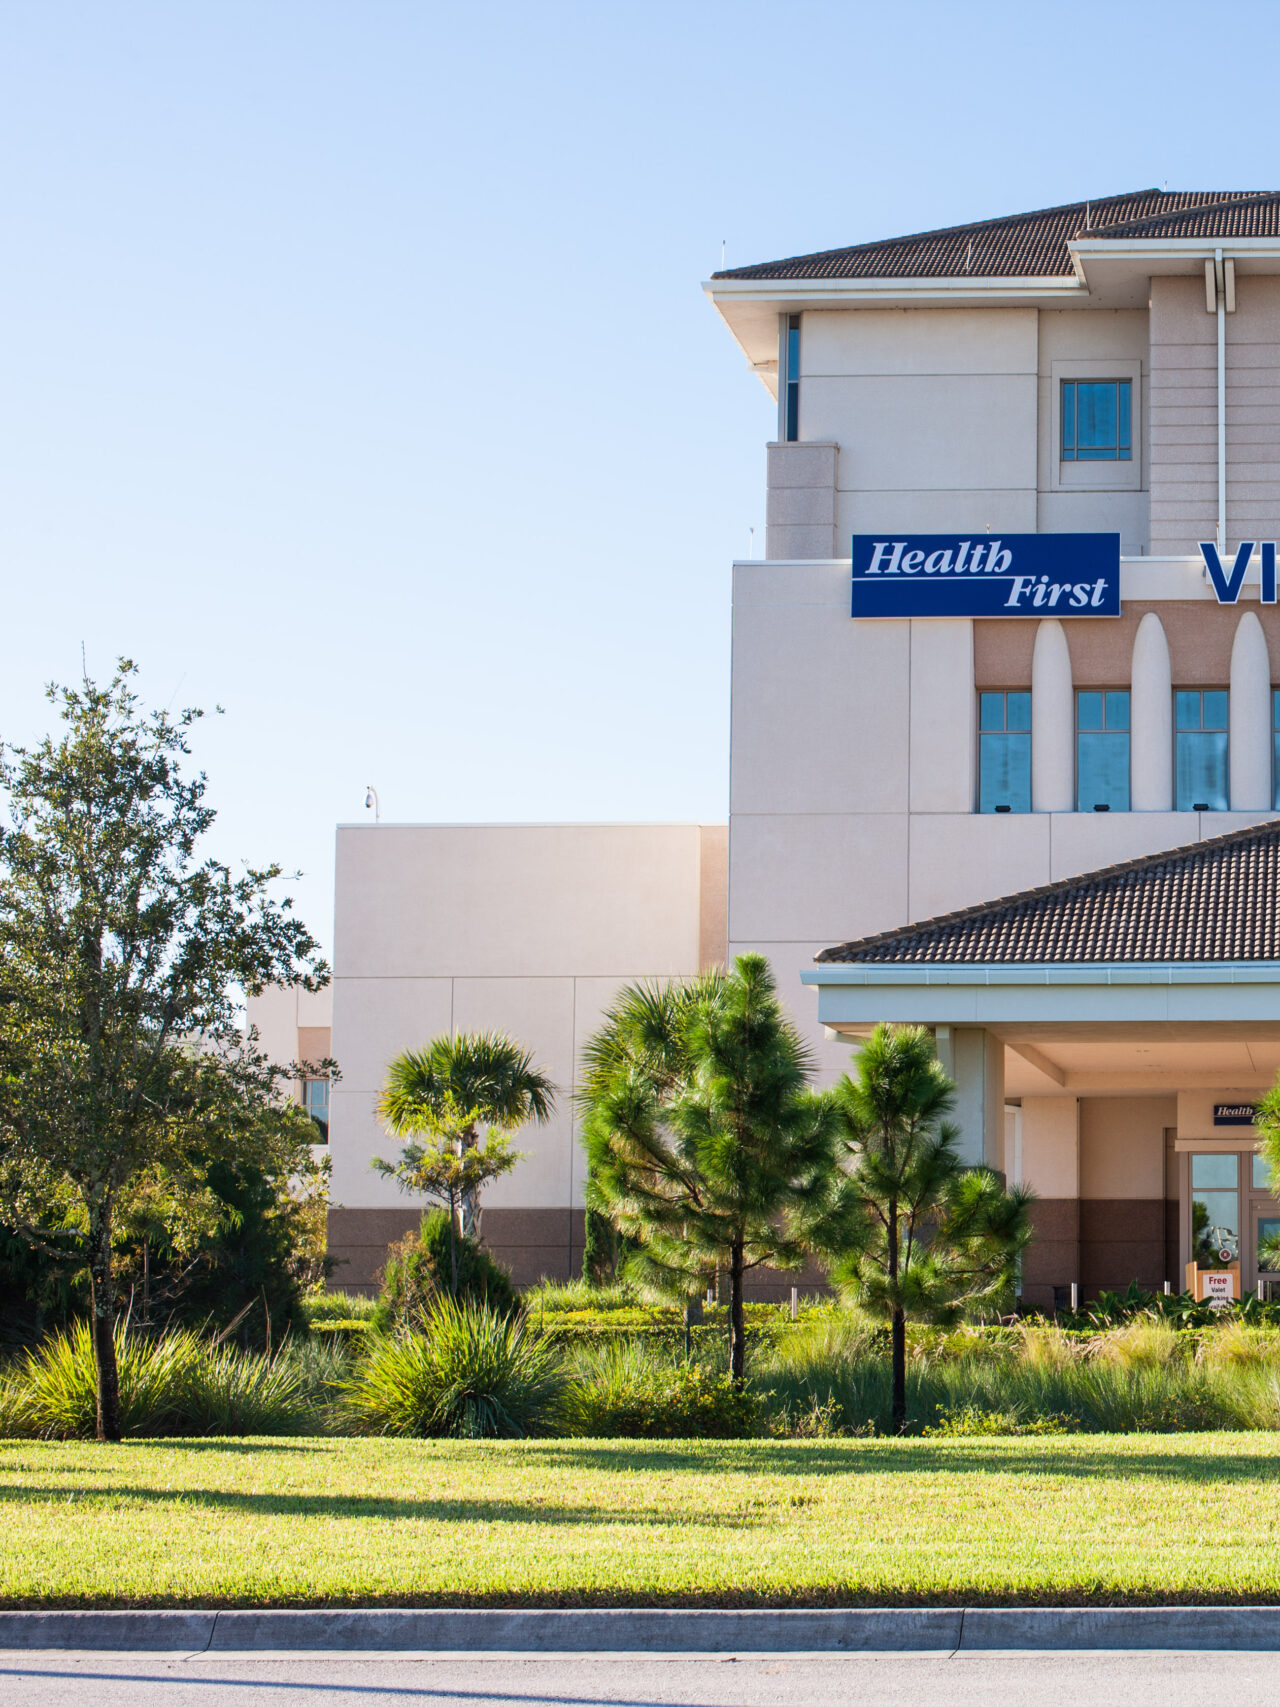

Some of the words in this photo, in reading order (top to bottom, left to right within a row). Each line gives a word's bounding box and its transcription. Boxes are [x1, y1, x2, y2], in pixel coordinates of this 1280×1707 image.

[864, 540, 1012, 574] Health
[1003, 575, 1108, 607] First
[1217, 1106, 1254, 1116] Health
[1208, 1276, 1228, 1285] Free
